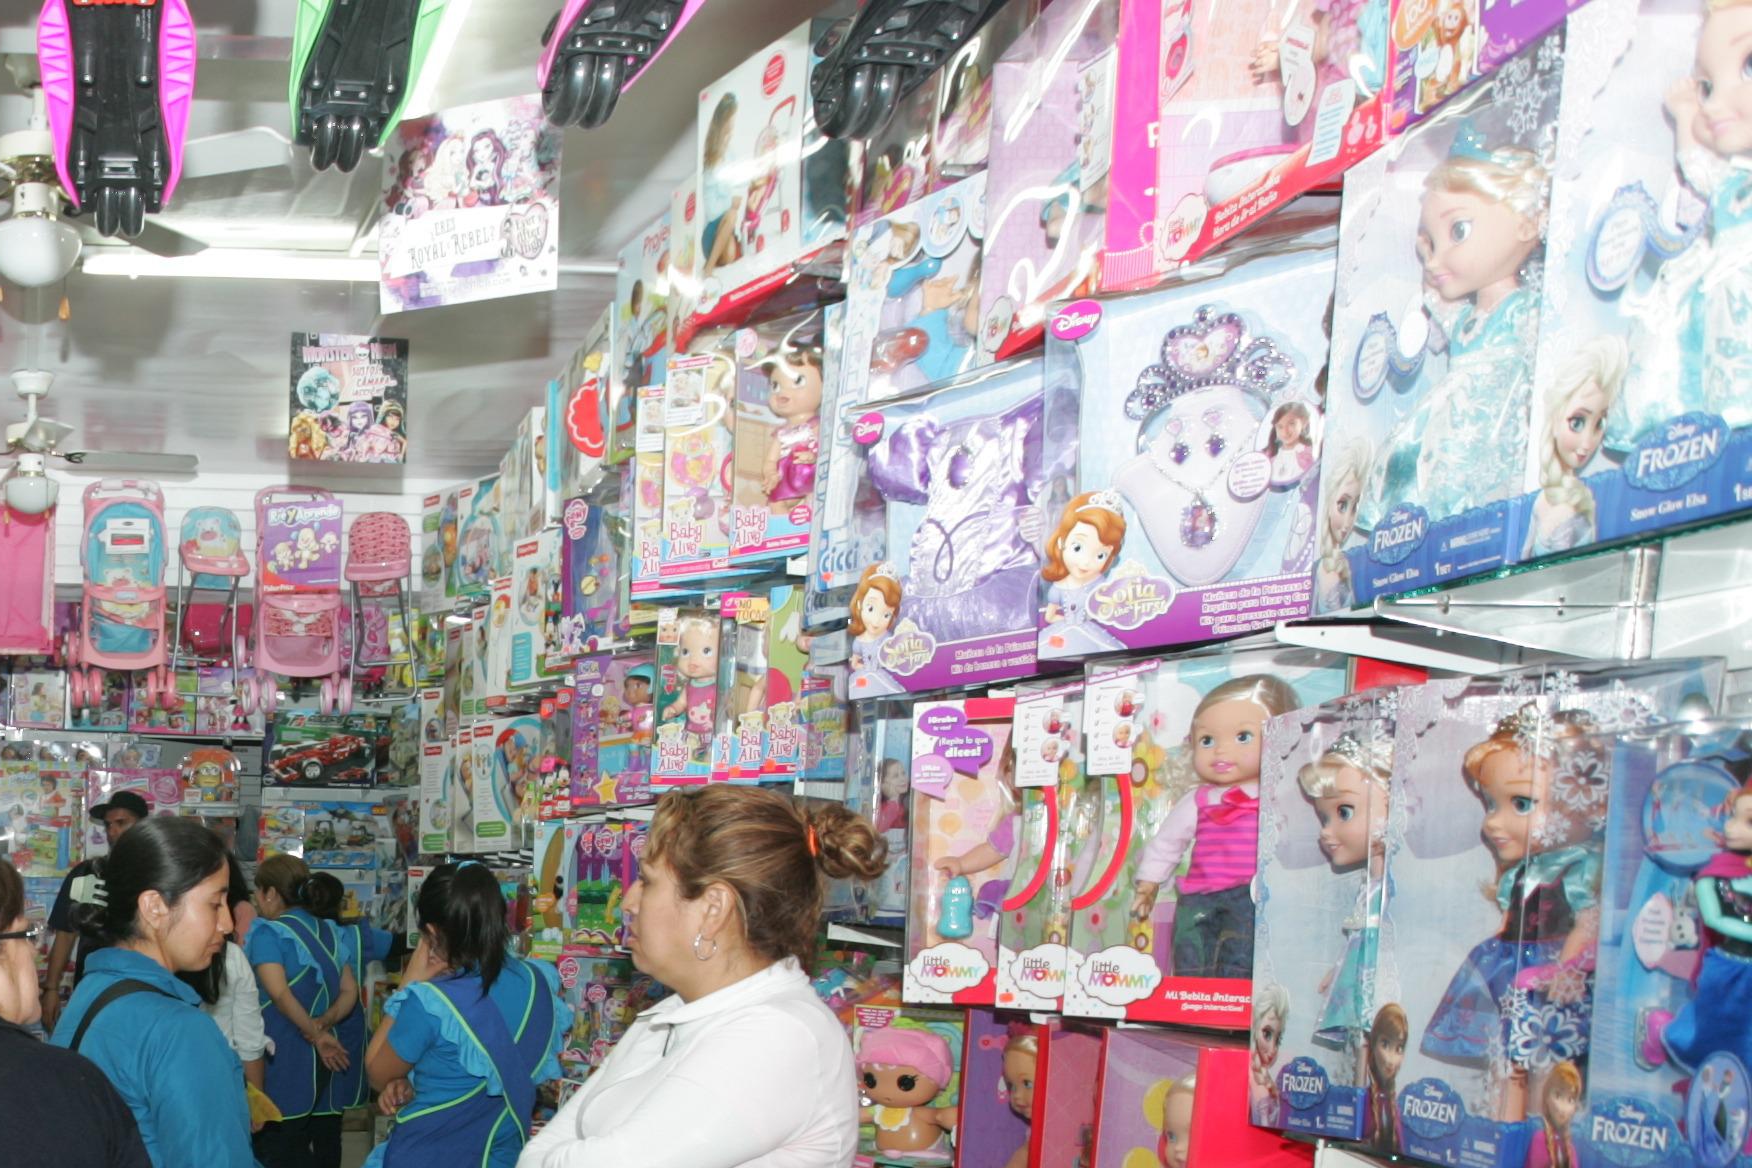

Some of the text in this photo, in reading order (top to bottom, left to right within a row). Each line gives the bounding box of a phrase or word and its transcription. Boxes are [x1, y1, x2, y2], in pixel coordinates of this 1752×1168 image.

[1050, 311, 1102, 332] Disney
[1667, 422, 1697, 442] Disney
[1636, 428, 1719, 479] FROZEN
[1629, 494, 1708, 522] Snow Glow Elsa
[734, 510, 766, 532] Baby
[670, 522, 702, 543] Baby
[733, 528, 761, 547] Alive
[1373, 517, 1423, 553] FROZEN
[668, 539, 698, 558] Alive
[769, 724, 797, 744] Baby
[659, 742, 688, 761] Baby
[768, 742, 793, 758] Alive
[658, 757, 685, 772] Alive
[923, 954, 950, 968] little
[1022, 956, 1050, 970] little
[1091, 959, 1121, 974] little
[920, 965, 982, 979] MOMMY
[1088, 972, 1156, 990] MOMMY
[1164, 990, 1210, 1002] Mi Bebita
[1282, 1072, 1324, 1094] FROZEN
[1403, 1093, 1458, 1123] FROZEN
[1591, 1115, 1668, 1152] FROZEN
